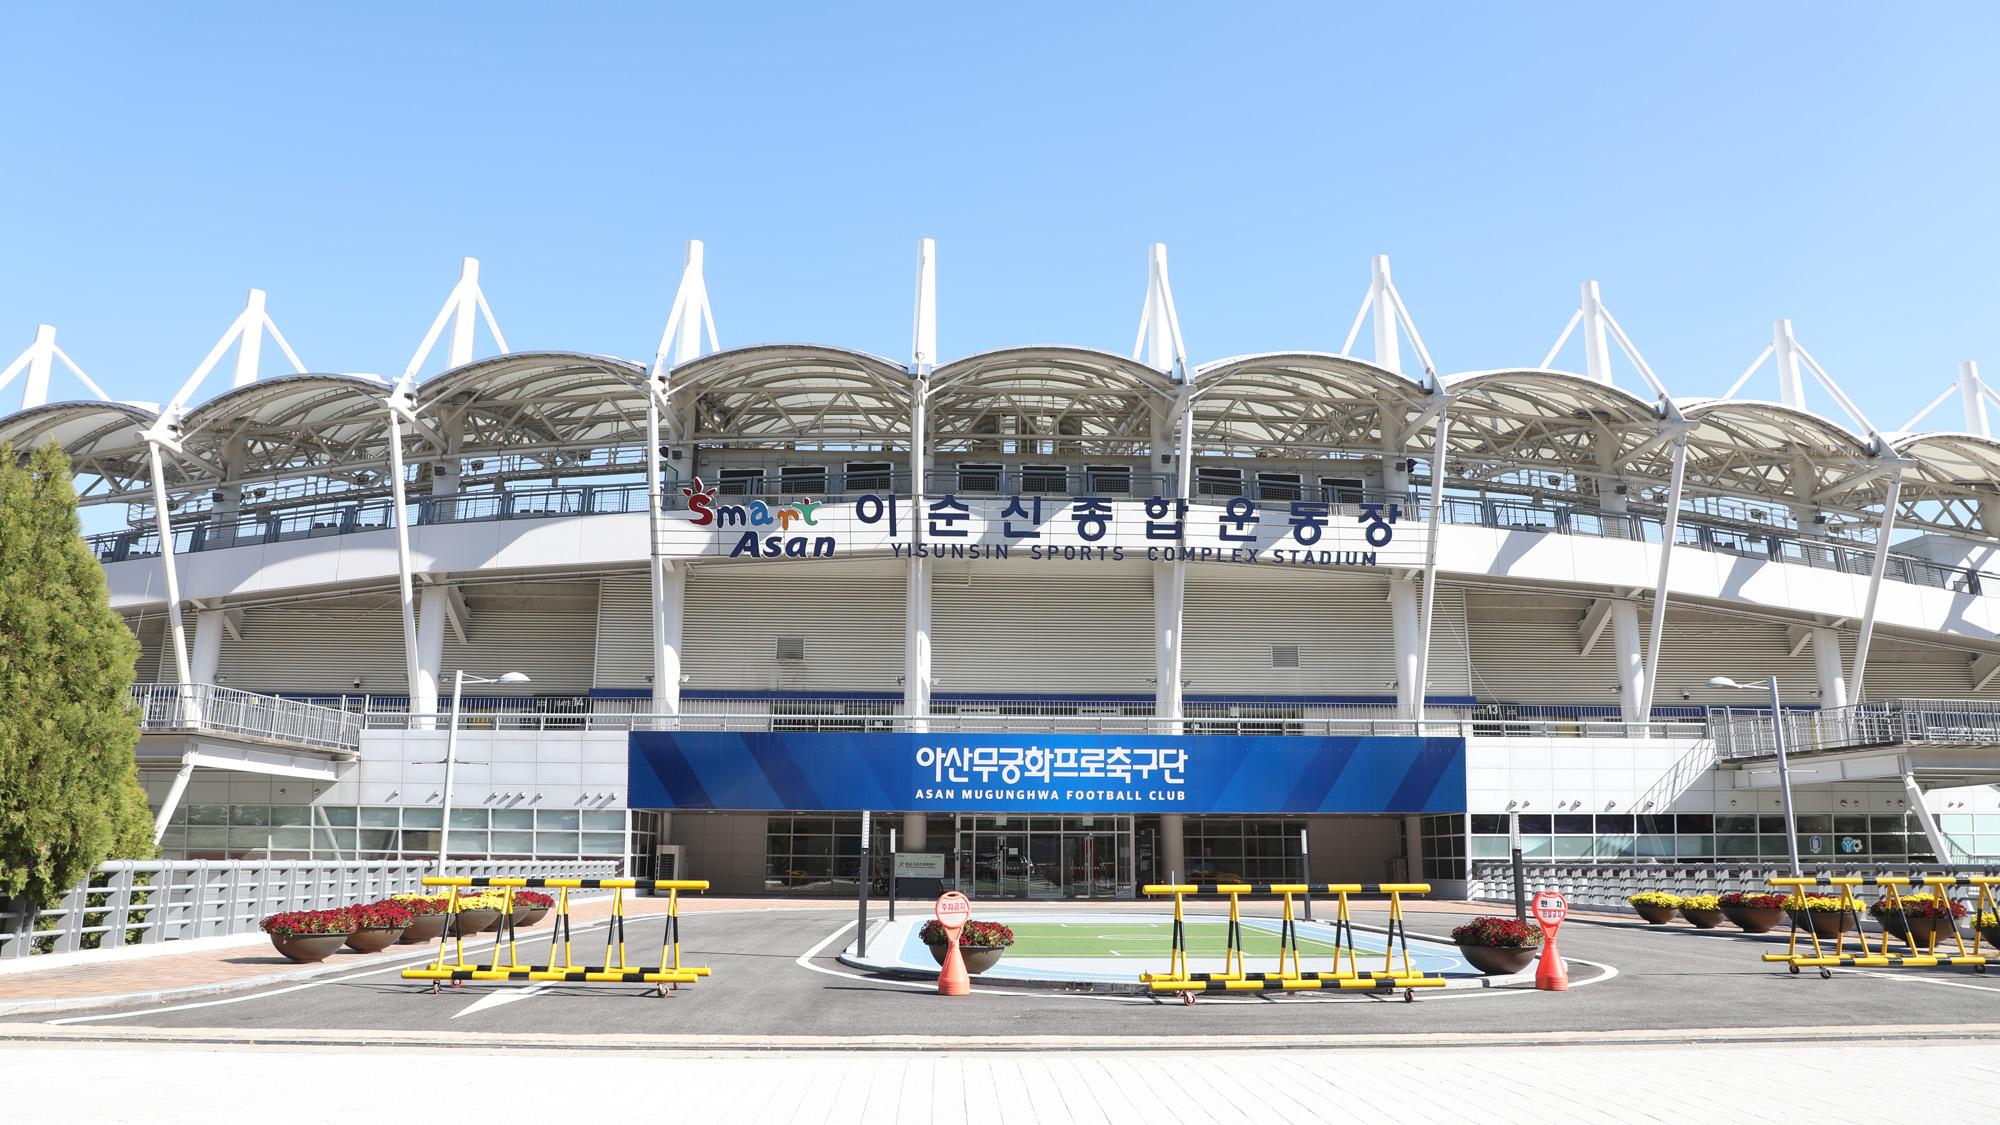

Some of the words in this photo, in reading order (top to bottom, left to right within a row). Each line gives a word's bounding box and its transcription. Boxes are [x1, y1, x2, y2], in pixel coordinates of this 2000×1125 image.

[687, 493, 822, 531] Smart
[729, 530, 836, 558] Asan
[891, 543, 1009, 560] YISUNSIN
[1030, 545, 1124, 561] SPORTS
[1147, 546, 1259, 564] COMPLEX
[1273, 549, 1377, 566] STADIUM
[1487, 704, 1499, 715] 13
[915, 745, 1189, 785] 아산무궁화프로축구단
[915, 789, 954, 799] ASAN
[961, 789, 1059, 800] MUGUNGHWA
[1066, 790, 1142, 801] FOOTBALL
[1149, 790, 1186, 801] CLUB
[941, 902, 966, 911] 주차금지
